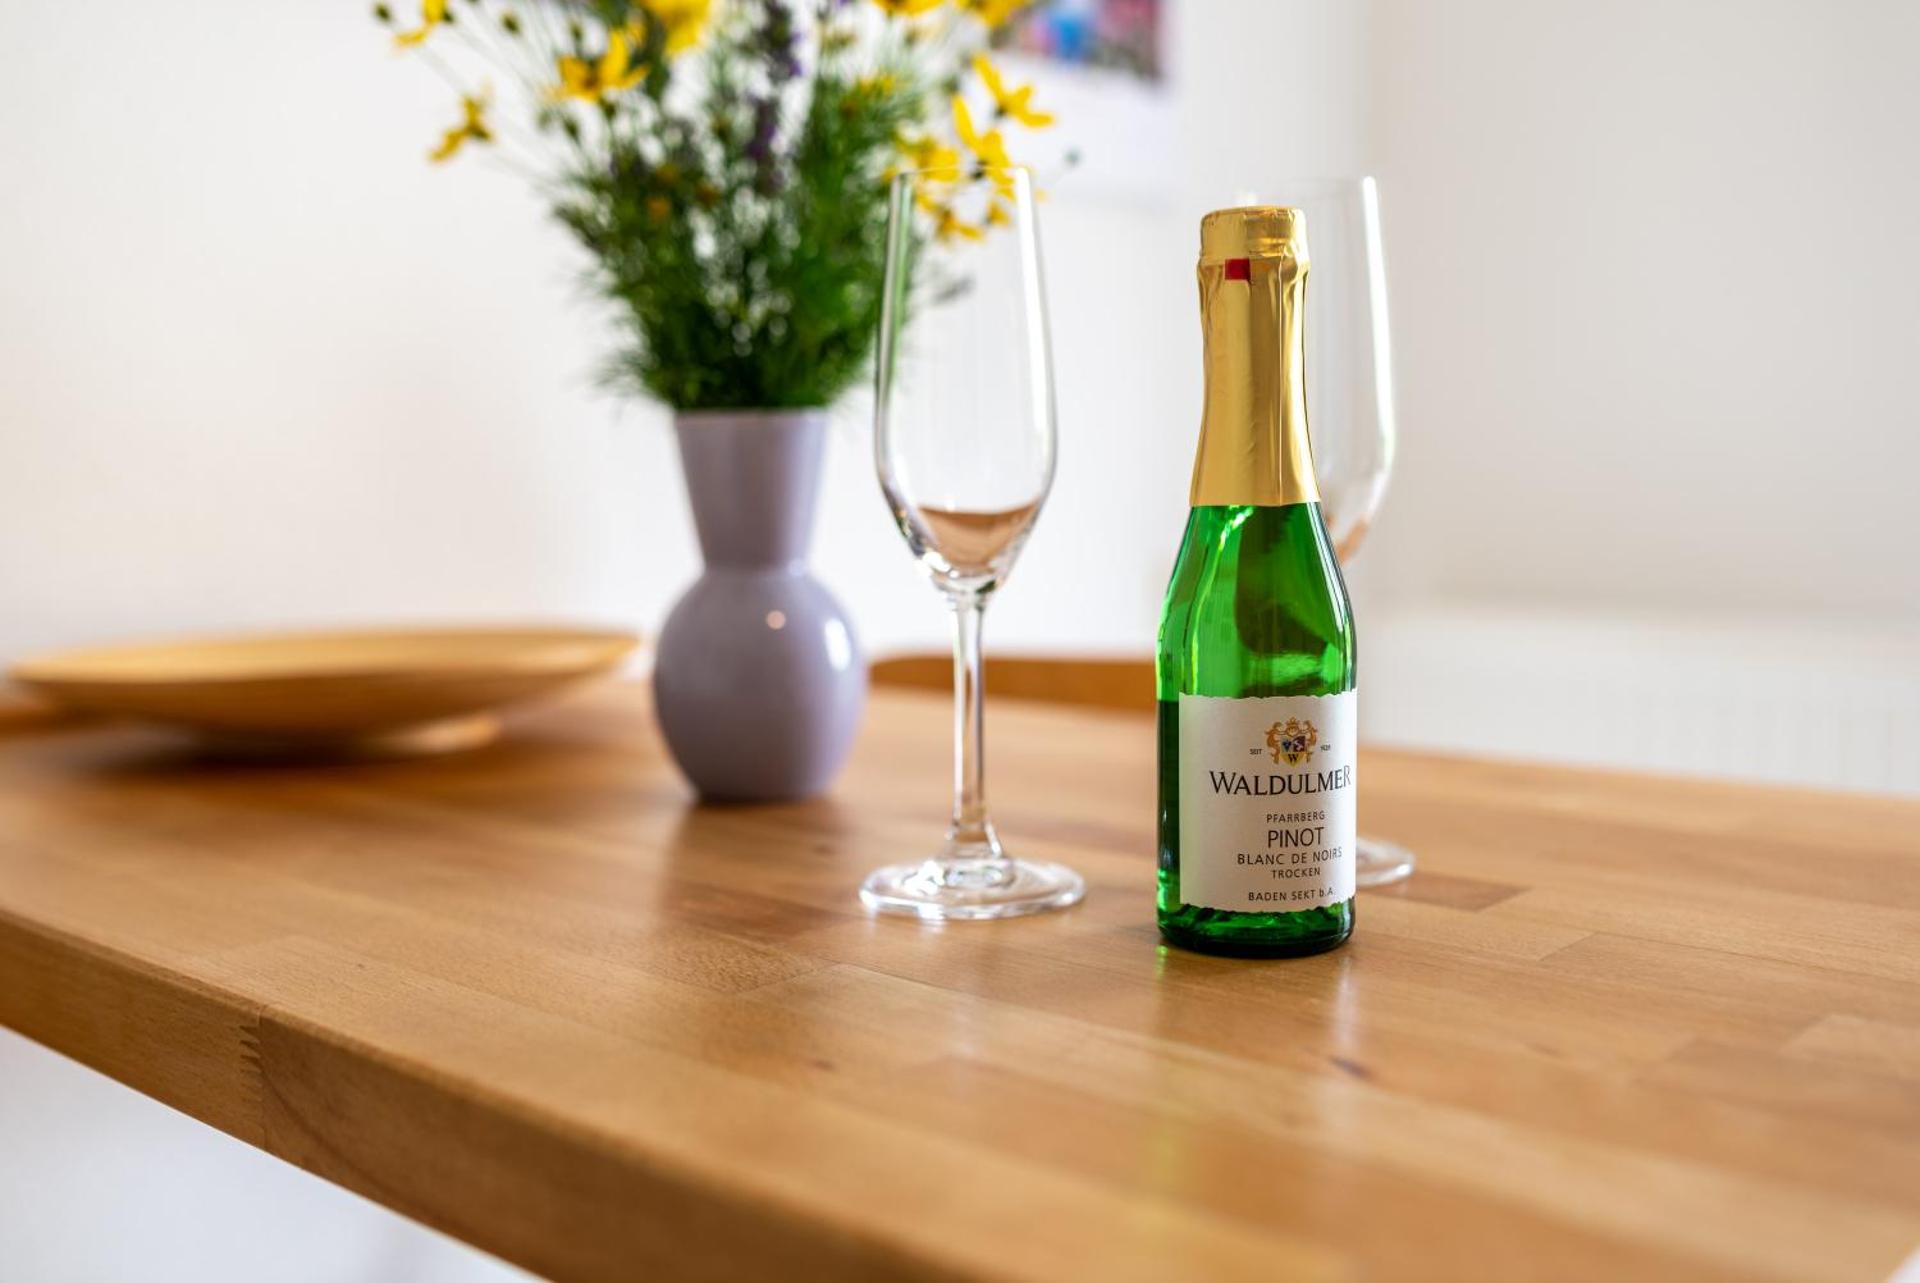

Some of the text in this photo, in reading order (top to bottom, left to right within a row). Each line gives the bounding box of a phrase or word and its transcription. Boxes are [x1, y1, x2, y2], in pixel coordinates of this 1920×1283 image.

[1288, 754, 1298, 763] W
[1209, 765, 1351, 795] WALDULMER
[1266, 811, 1325, 823] PFARRBERG
[1267, 826, 1325, 849] PINOT
[1237, 846, 1343, 866] BLANC DE NOIRS
[1271, 867, 1321, 879] TROCKEN
[1248, 891, 1287, 902] BADEN
[1291, 889, 1315, 900] SEKT
